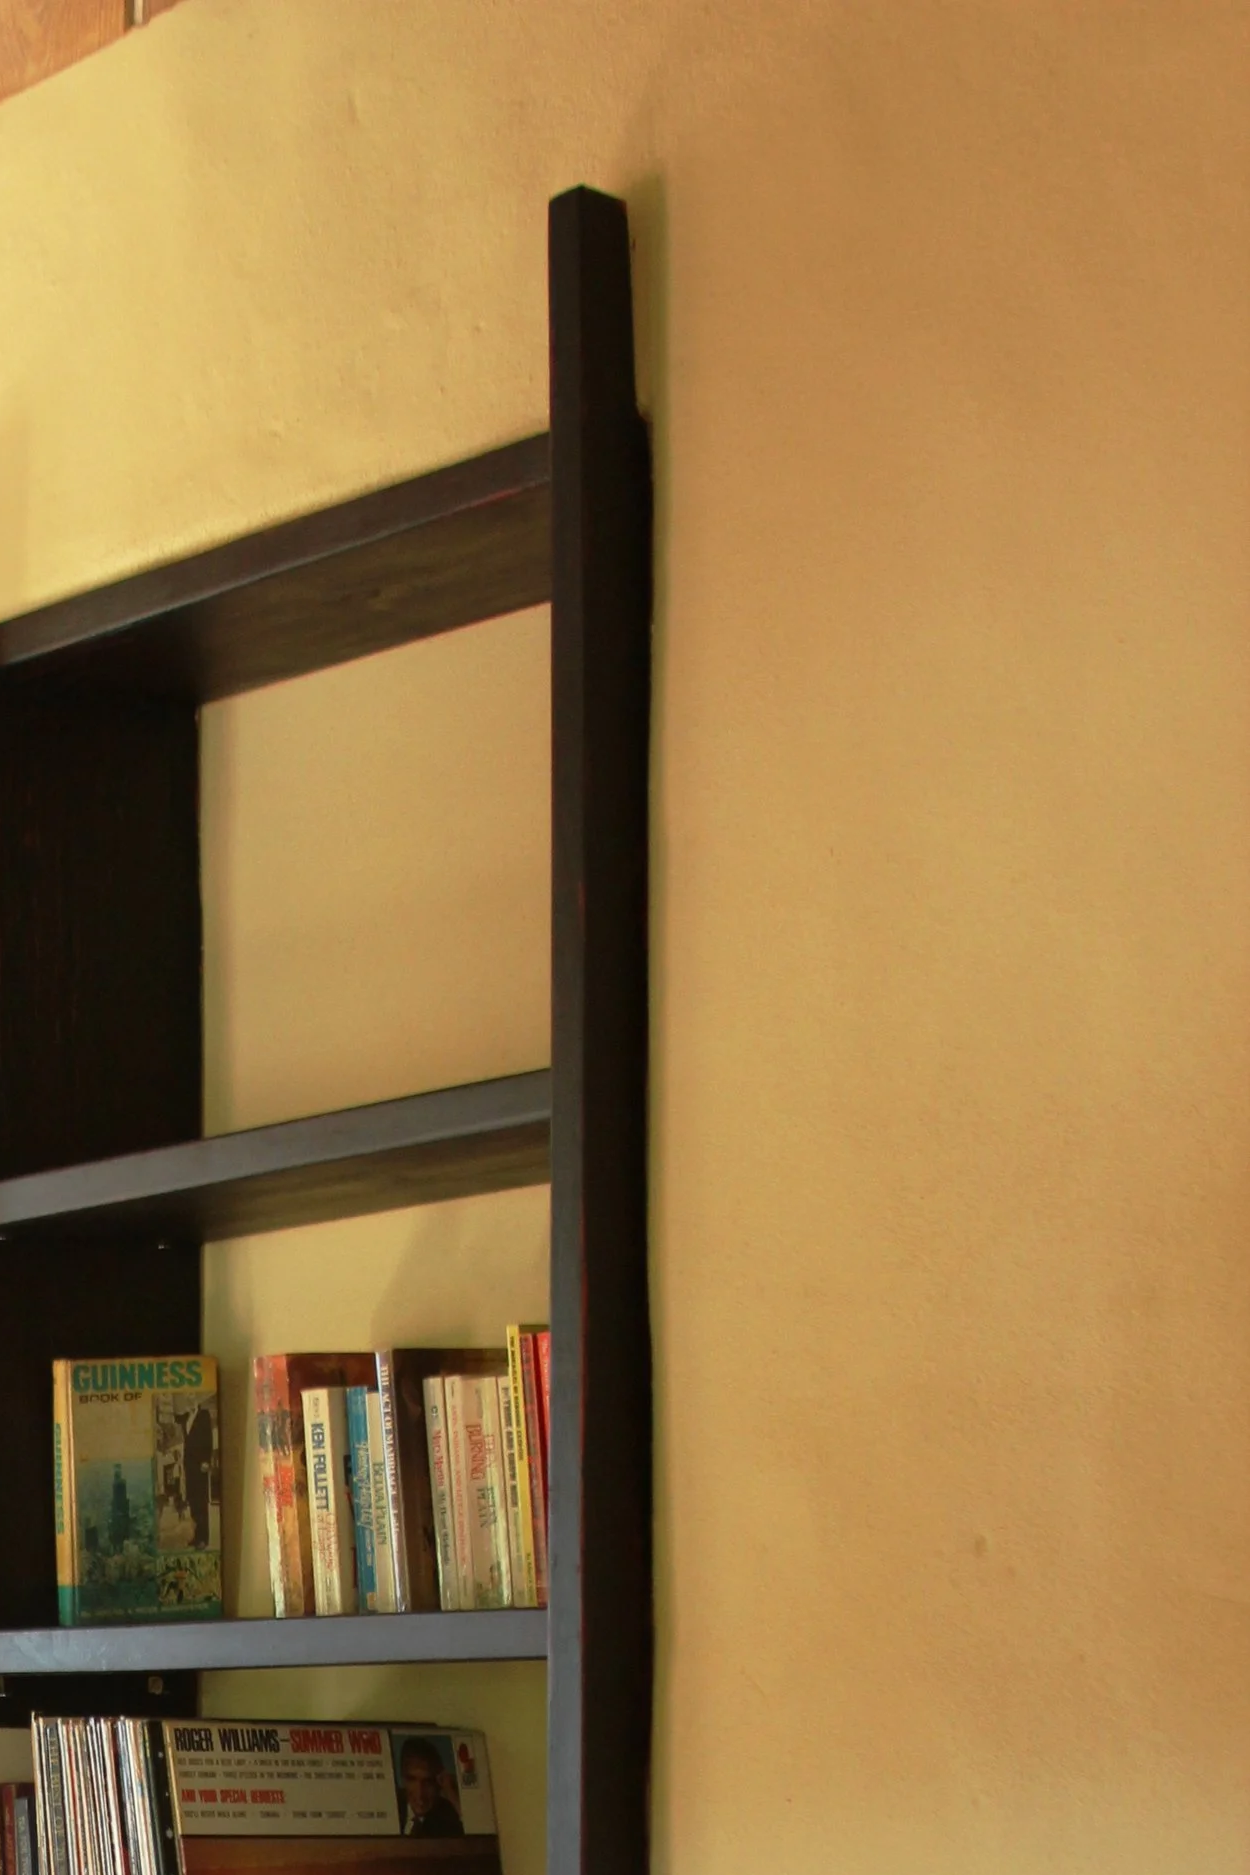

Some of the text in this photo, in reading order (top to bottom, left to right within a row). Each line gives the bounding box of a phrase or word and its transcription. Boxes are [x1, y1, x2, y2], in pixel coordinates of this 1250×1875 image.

[74, 1361, 202, 1393] GUINNESS
[124, 1393, 142, 1402] OF
[383, 1391, 392, 1412] ACT
[311, 1422, 325, 1450] KEN
[386, 1434, 398, 1496] MARRIAGE
[465, 1424, 486, 1481] BURNING
[314, 1454, 329, 1512] FOLLETT
[372, 1461, 388, 1546] BELVA PLAIN
[49, 1738, 59, 1766] THE
[174, 1727, 214, 1752] ROGER
[347, 1729, 383, 1755] WIND
[51, 1774, 62, 1806] BEST
[181, 1789, 196, 1803] AND
[198, 1789, 217, 1803] YOUR
[220, 1789, 247, 1804] SPECIAL
[55, 1817, 64, 1837] OF
